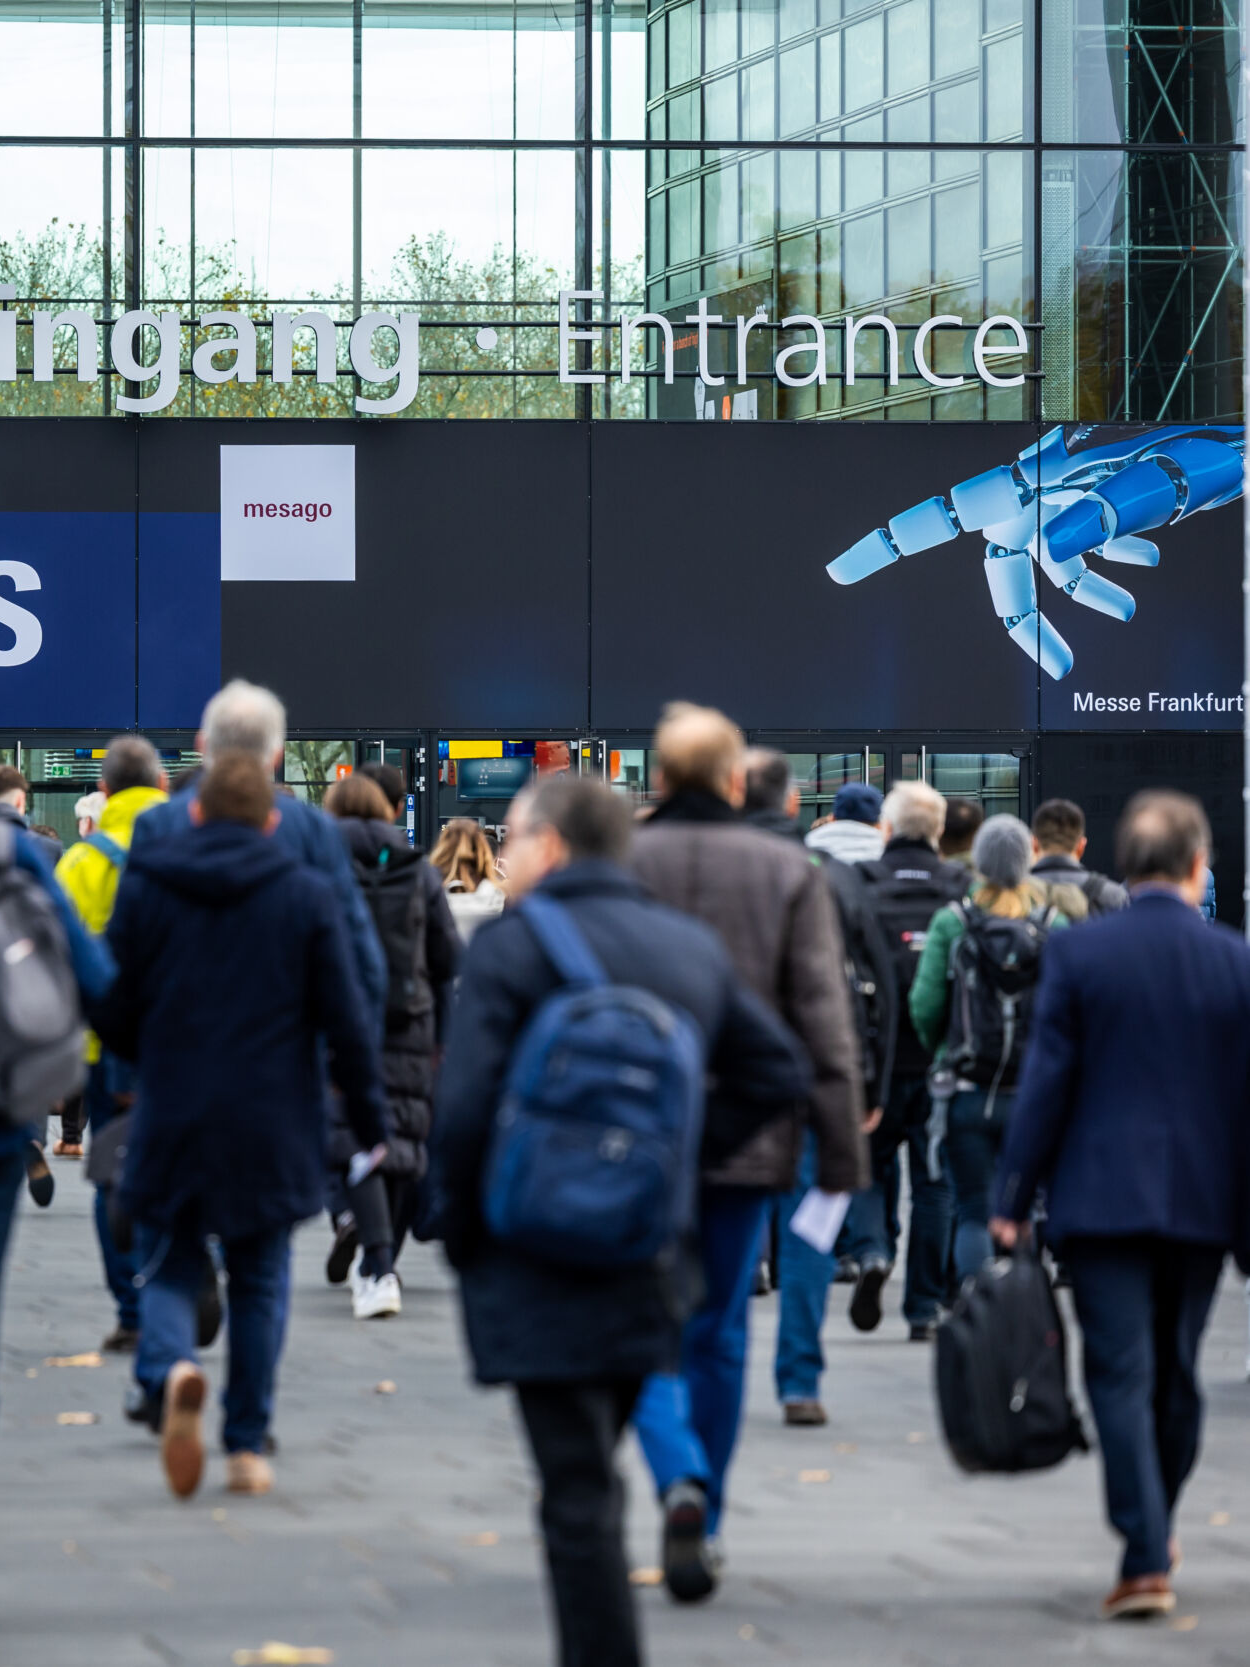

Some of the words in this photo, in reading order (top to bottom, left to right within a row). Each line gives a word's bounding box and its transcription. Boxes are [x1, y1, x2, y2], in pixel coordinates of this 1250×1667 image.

[558, 290, 1028, 387] Entrance
[243, 502, 332, 522] mesago
[1073, 692, 1141, 712] Messe
[1148, 692, 1243, 712] Frankfurt
